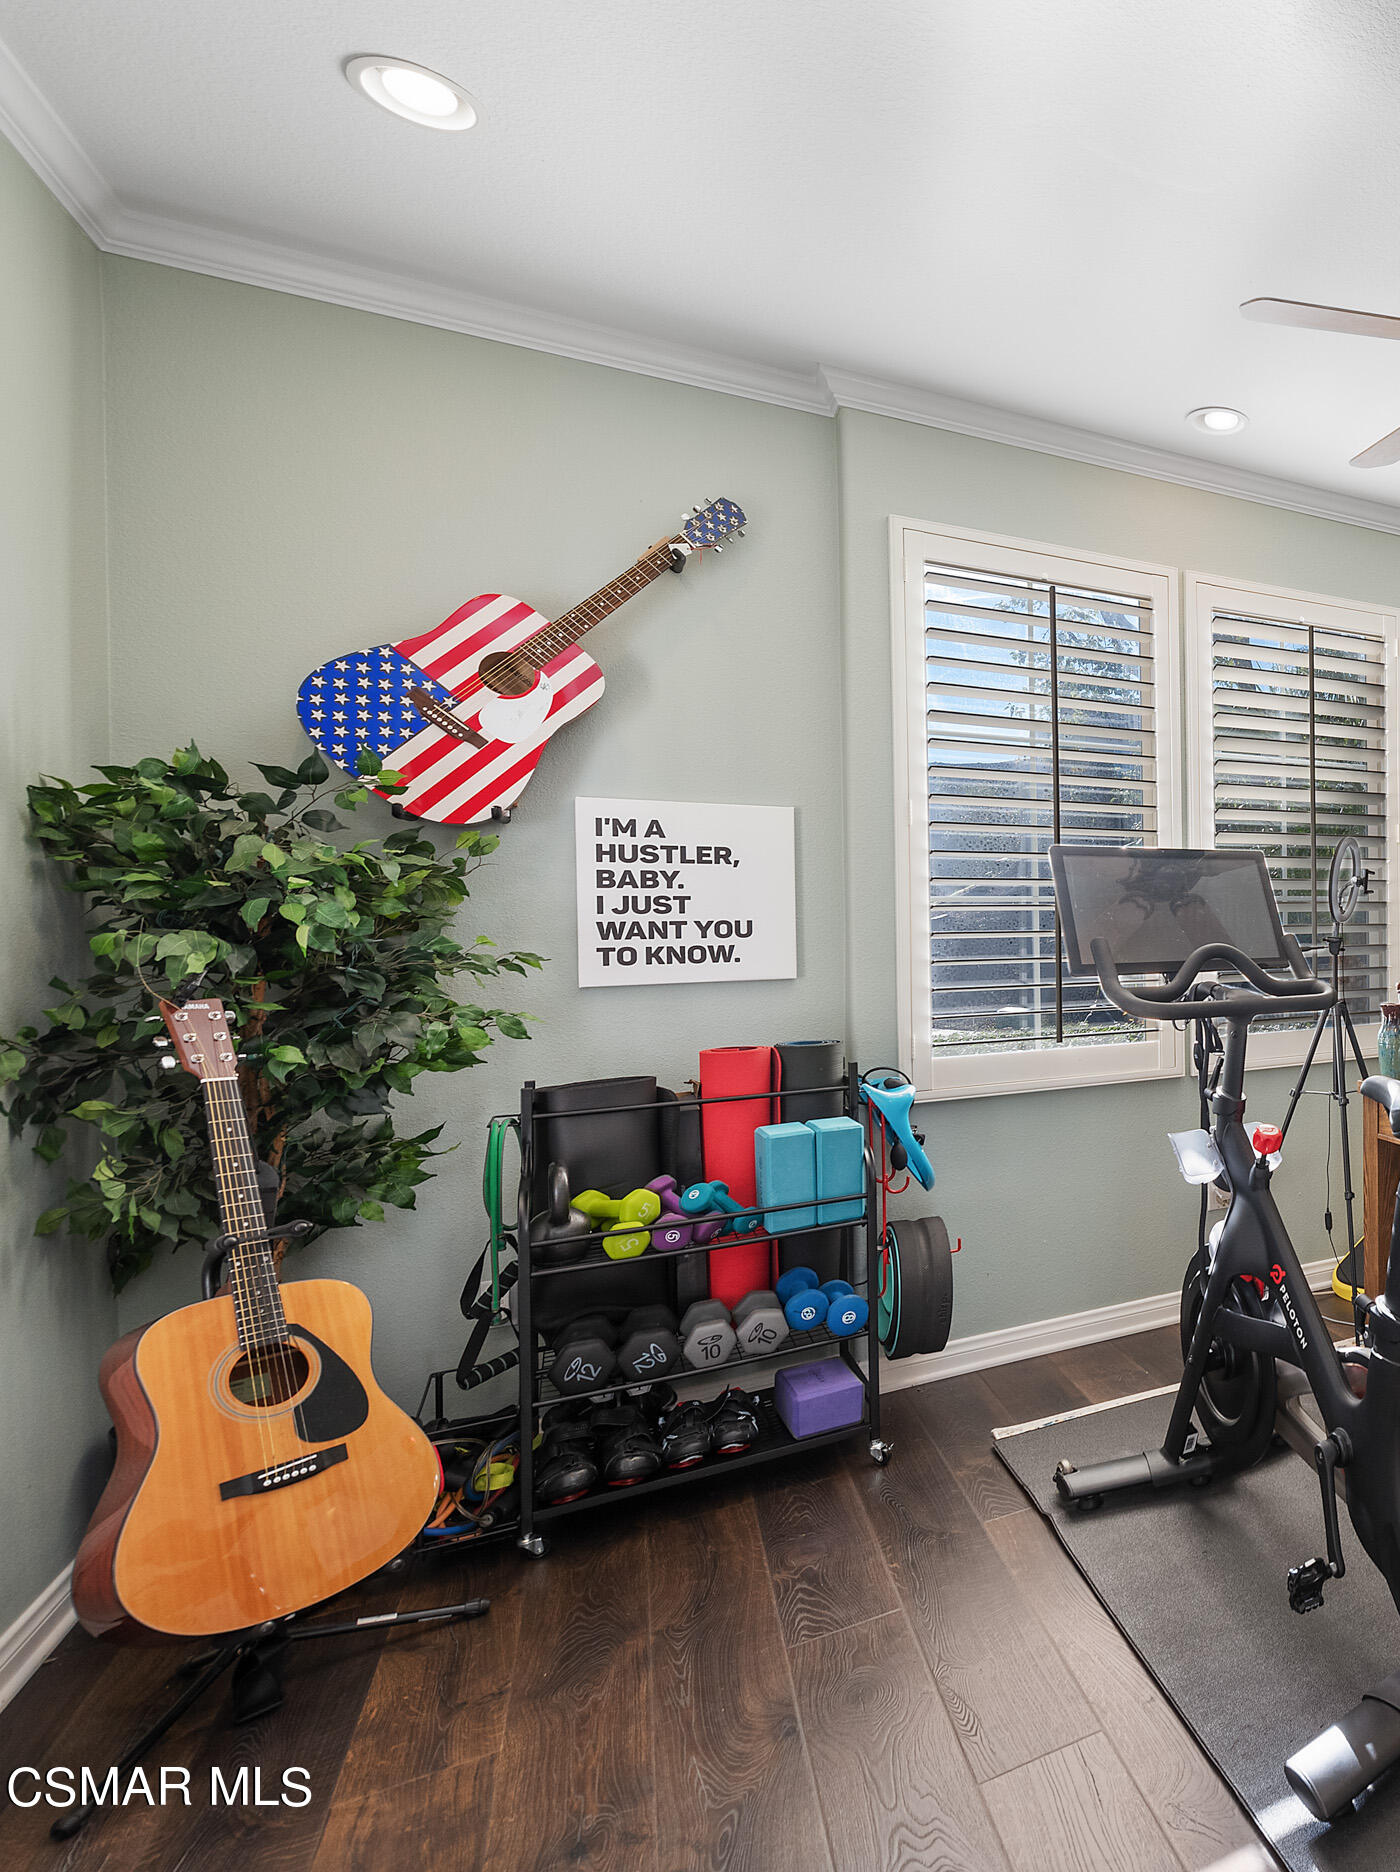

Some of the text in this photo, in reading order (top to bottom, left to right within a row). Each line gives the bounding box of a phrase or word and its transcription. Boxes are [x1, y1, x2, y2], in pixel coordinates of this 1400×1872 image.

[595, 817, 666, 838] I'M A
[595, 843, 740, 868] HUSTLER,
[596, 869, 684, 889] BABY.
[596, 895, 691, 914] I JUST
[596, 919, 753, 940] WANT YOU
[596, 944, 741, 966] TO KNOW.
[638, 1202, 651, 1219] 5
[1279, 1284, 1308, 1349] PELOTON
[758, 1328, 777, 1345] 10
[701, 1344, 721, 1361] 10
[577, 1363, 602, 1383] 12
[632, 1352, 656, 1374] 12
